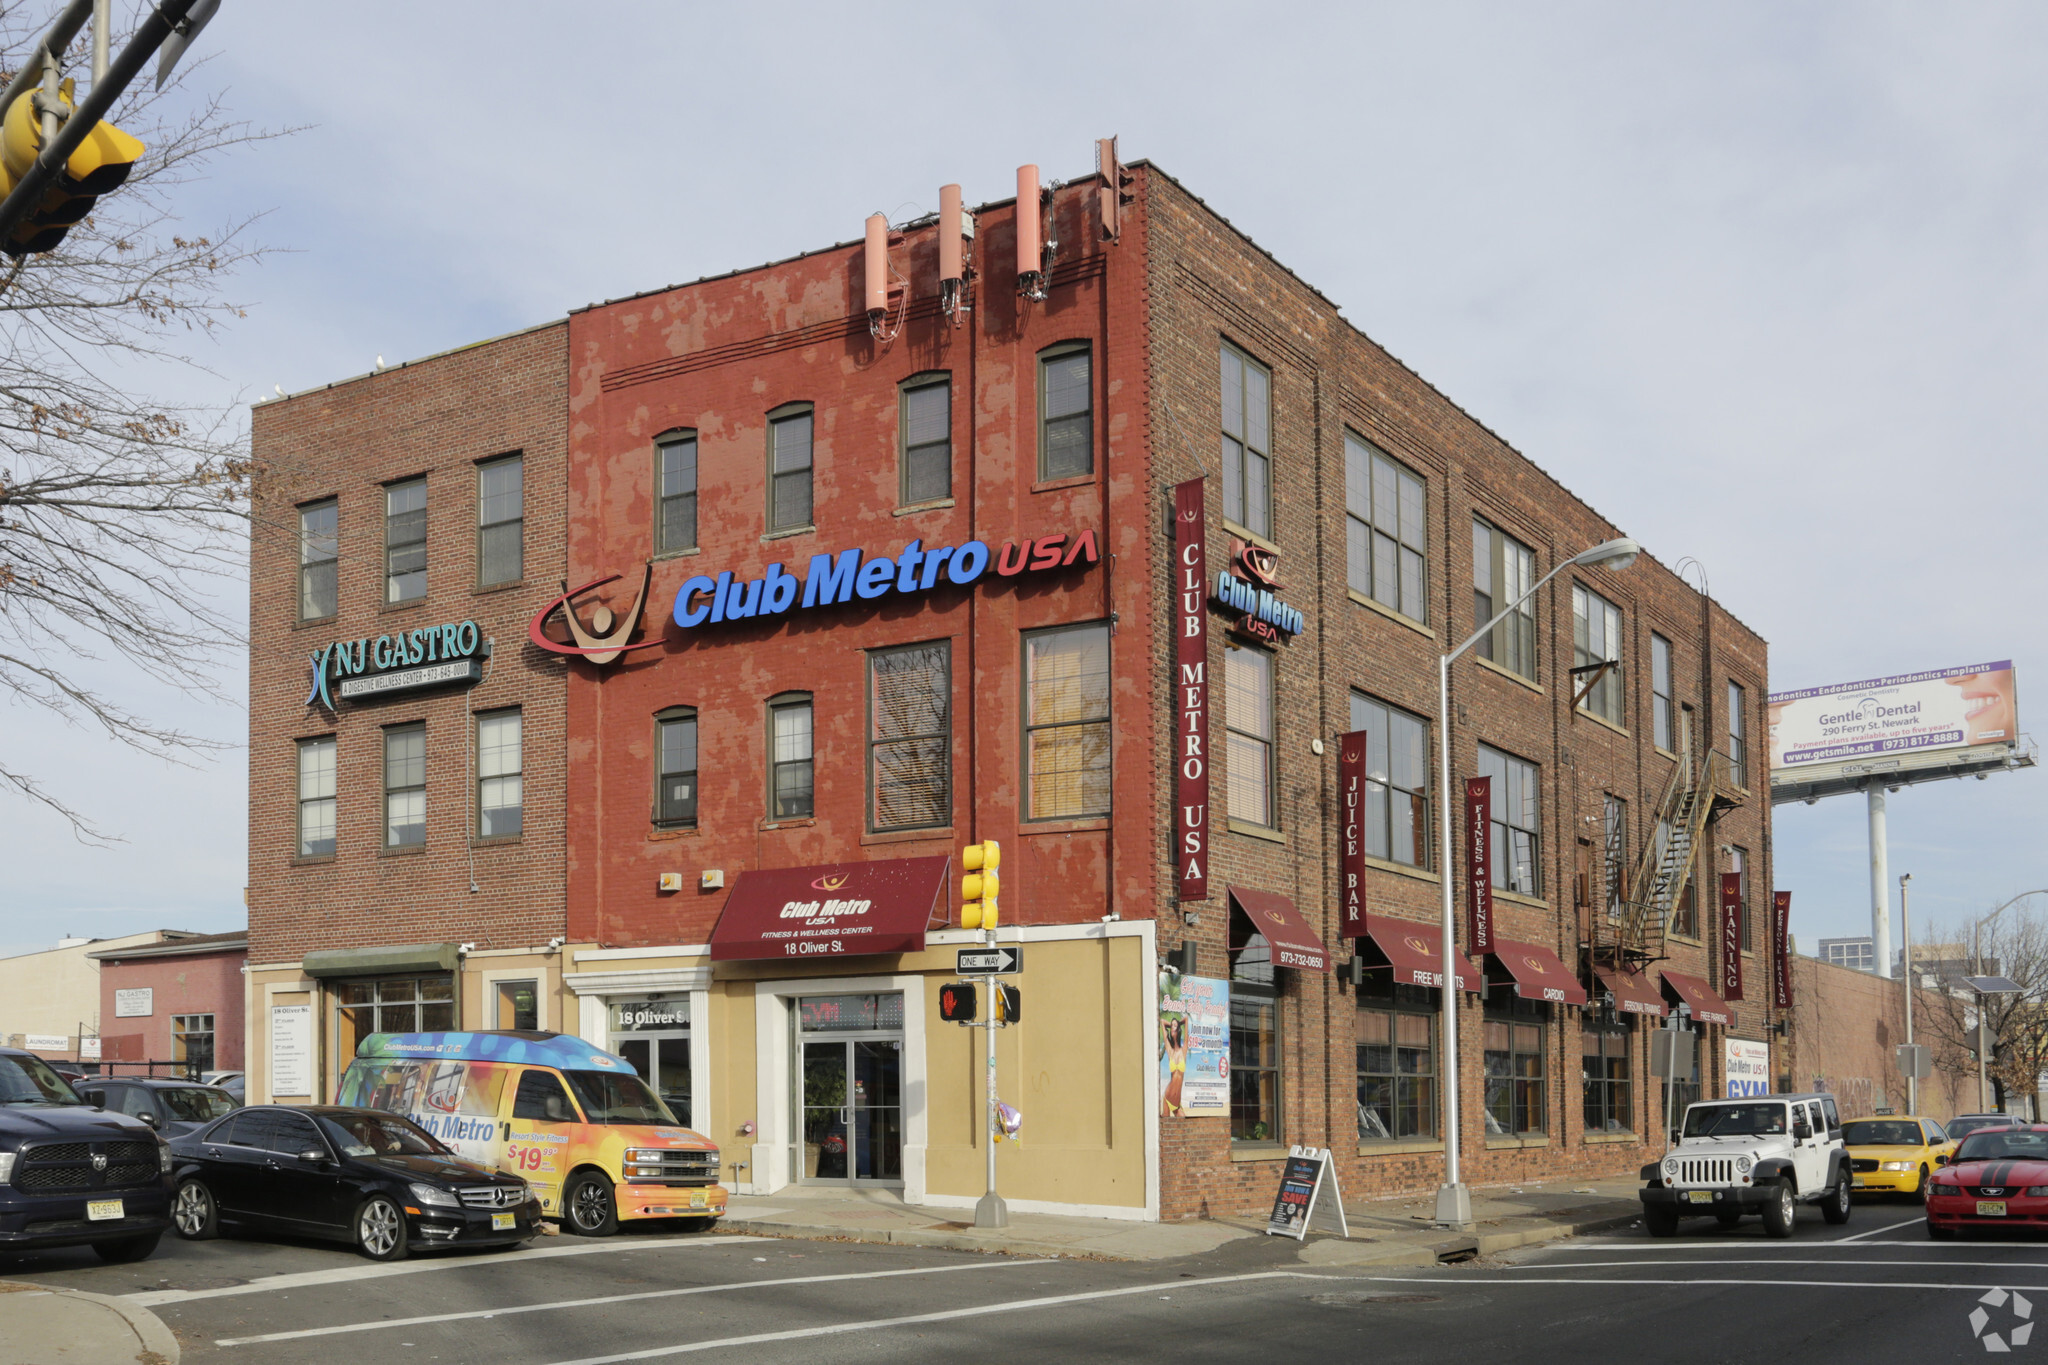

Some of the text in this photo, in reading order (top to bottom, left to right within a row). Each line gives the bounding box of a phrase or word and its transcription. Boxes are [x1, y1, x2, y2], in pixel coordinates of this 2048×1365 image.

[672, 528, 1098, 629] Club Metro USA
[1218, 570, 1304, 635] Club Metro
[1246, 613, 1278, 642] USA
[335, 619, 479, 676] NJ GASTRO
[343, 662, 468, 695] A DIGESTIVE WELLNESS CENTER 973-645-0000
[1818, 681, 1876, 695] Endodontics
[1880, 671, 1942, 684] Periodontics
[1946, 663, 1991, 677] Implants
[1837, 686, 1900, 701] Cosmetic Dentistry
[1181, 542, 1205, 880] CLUB METRO USA
[1818, 700, 1921, 726] Gentle Dental
[1822, 715, 1920, 737] 290 Ferry St. Newark
[1786, 731, 1960, 763] www.getsmile.net (973) 817-8888
[1793, 739, 1827, 750] Payment
[1828, 736, 1849, 746] plans
[1851, 731, 1888, 742] available,
[1889, 728, 1901, 737] up
[1901, 726, 1911, 735] to
[1912, 725, 1928, 734] five
[1346, 775, 1359, 921] JUICE BAR
[1474, 804, 1487, 948] FITNESS & WELLNESS
[779, 898, 872, 919] Club Metro
[805, 916, 835, 926] USA
[761, 926, 873, 939] FITNESS & WELLNESS CENTER
[784, 940, 845, 955] 18 Oliver St.
[1725, 904, 1738, 988] TANNING
[961, 955, 1000, 967] ONE WAY
[1280, 951, 1323, 969] 973-732-0650
[1776, 909, 1786, 1005] PERSONAL TRAINING
[1181, 976, 1213, 1003] Get your
[1413, 970, 1465, 989] FREE WETS
[1543, 987, 1565, 1001] CARDIO
[618, 1011, 634, 1025] 18
[634, 1010, 675, 1025] Oliver
[1624, 999, 1661, 1015] PERSONAL TRAINING
[1700, 1010, 1728, 1024] FREE PARKING
[1191, 1023, 1221, 1037] Join now for
[383, 1043, 436, 1052] ClubMetroUSA.com
[1205, 1039, 1223, 1049] month
[1727, 1058, 1767, 1075] Club Metro USA
[440, 1115, 495, 1142] Metro
[510, 1131, 569, 1143] Resort Style Fitness
[507, 1144, 542, 1171] $19
[1281, 1191, 1309, 1206] SAVE
